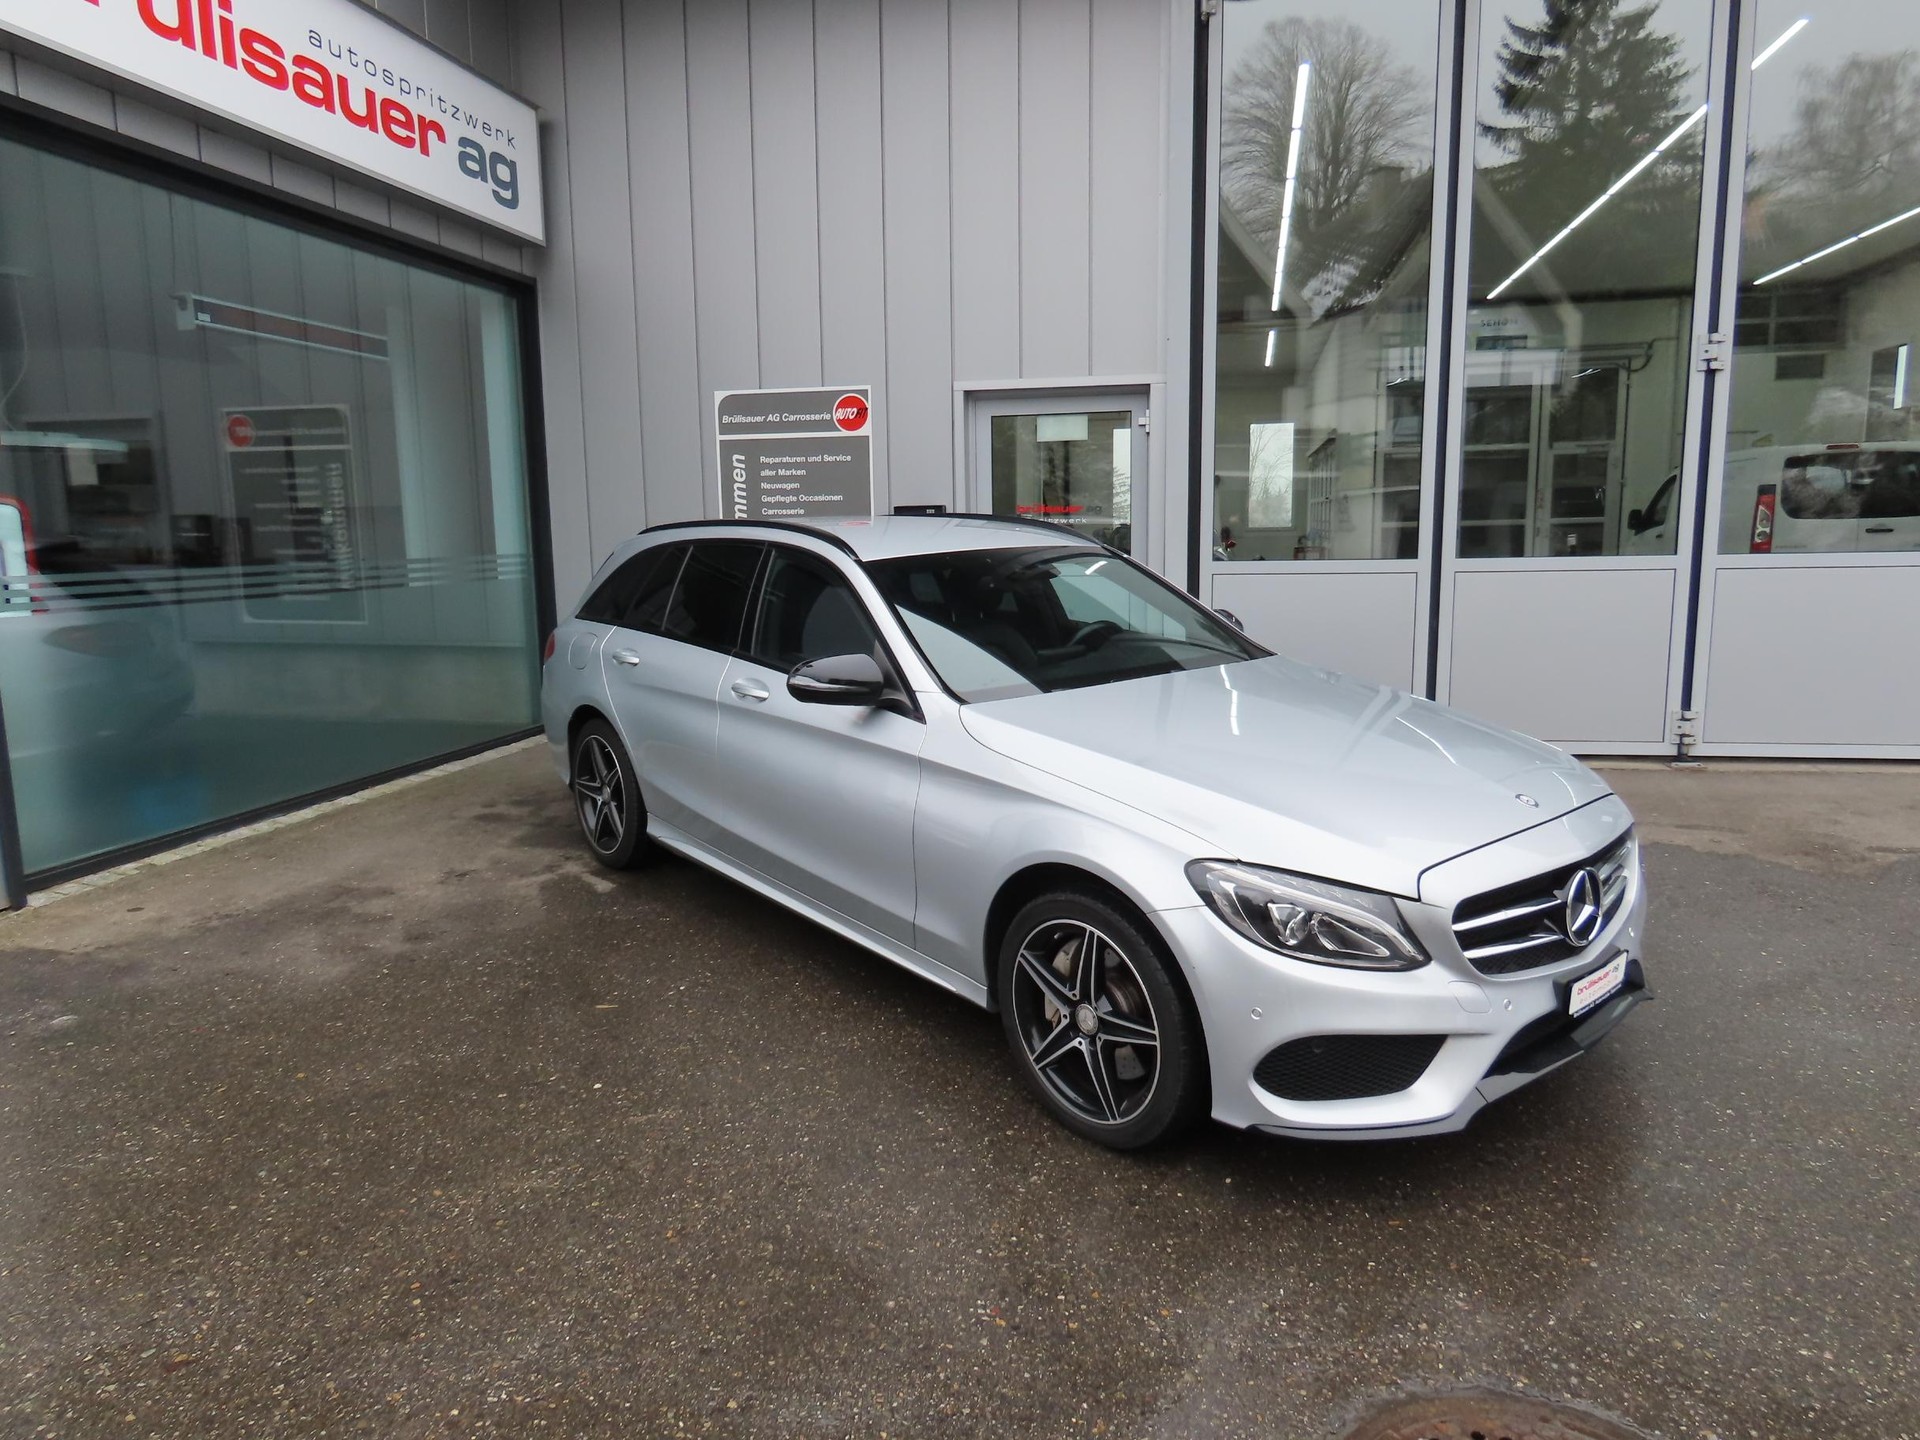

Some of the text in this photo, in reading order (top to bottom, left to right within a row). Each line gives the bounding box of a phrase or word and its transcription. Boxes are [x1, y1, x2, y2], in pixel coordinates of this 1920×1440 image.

[307, 29, 517, 150] autospritzwerk
[457, 136, 520, 210] ag
[722, 411, 831, 424] Brülisauer AG Carrosserie
[760, 455, 806, 465] Reparaturen
[823, 454, 852, 462] Service
[760, 469, 776, 477] aller
[761, 482, 800, 491] Neuwagen
[761, 494, 843, 504] Gepflegte Occasionen
[762, 507, 805, 515] Carrosserie
